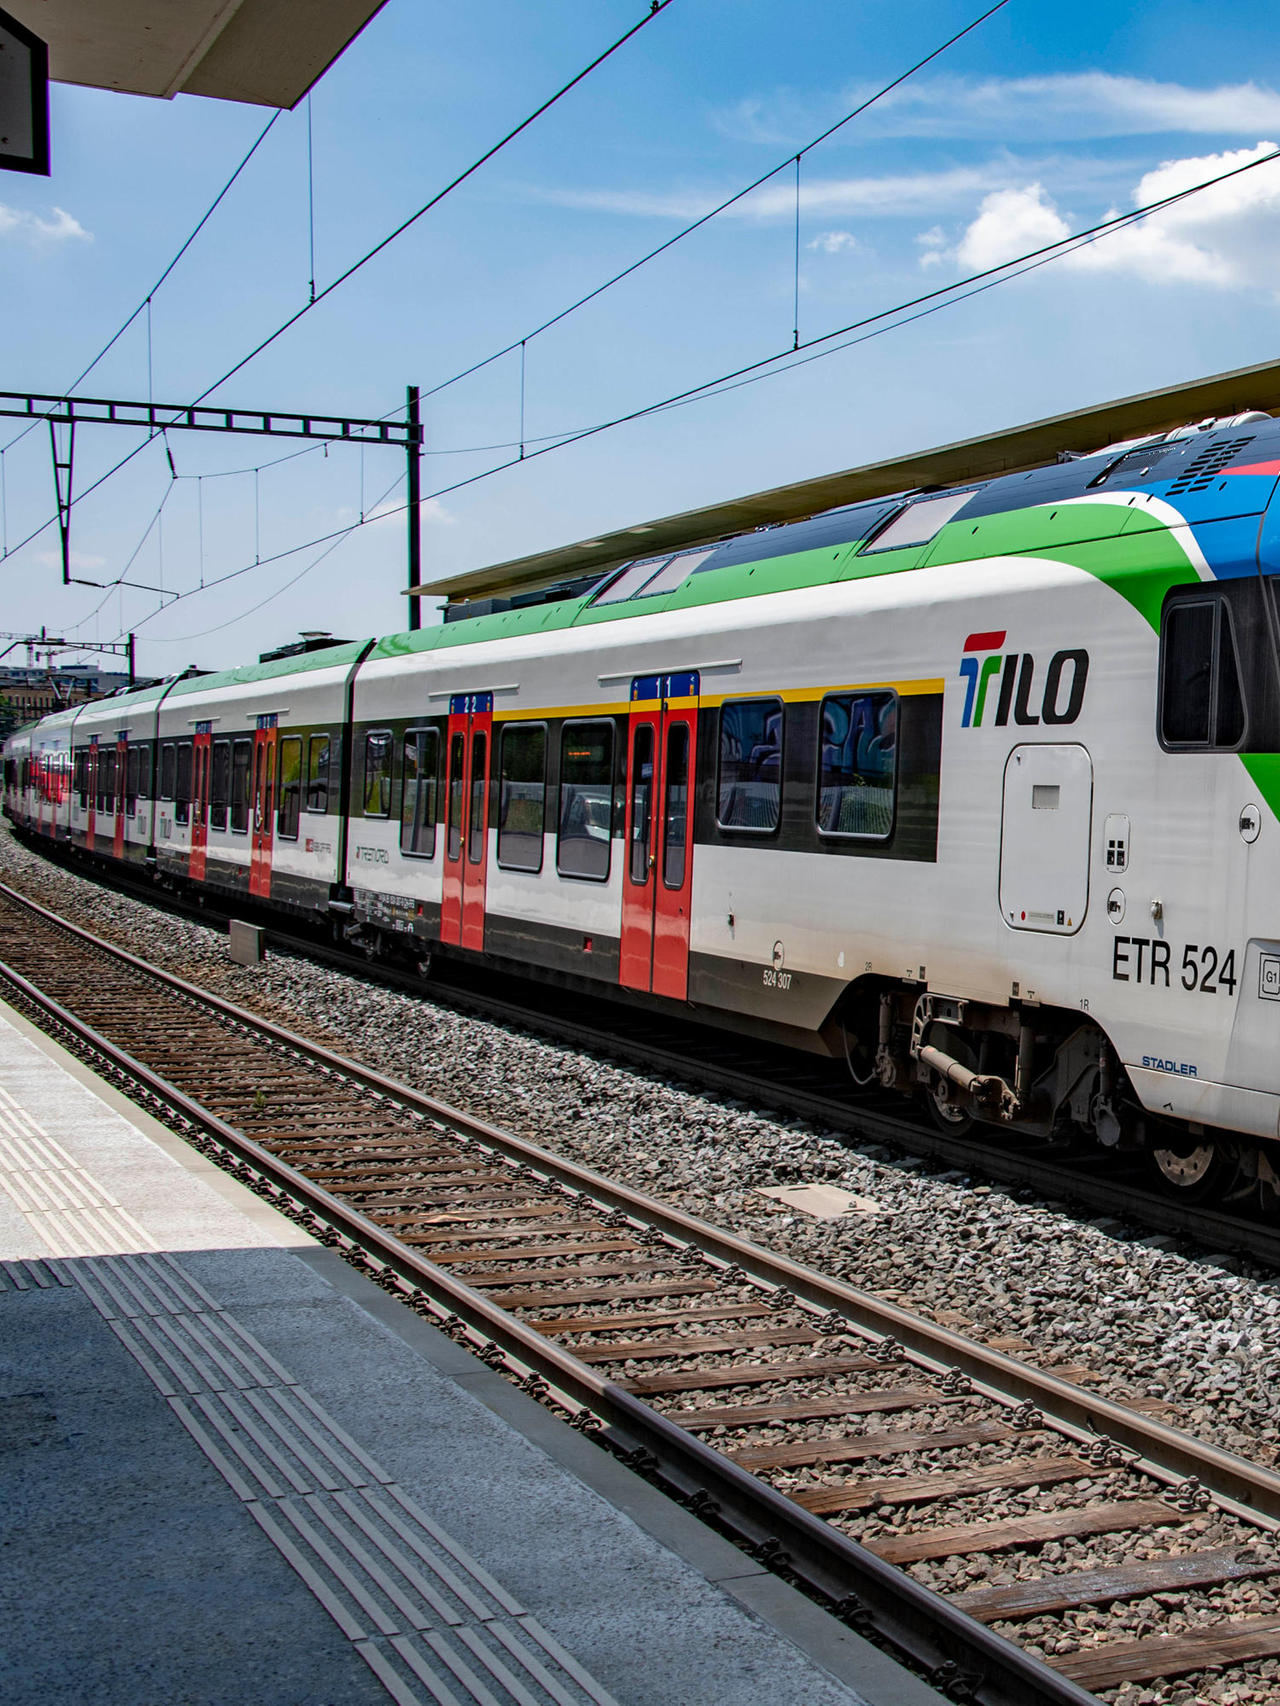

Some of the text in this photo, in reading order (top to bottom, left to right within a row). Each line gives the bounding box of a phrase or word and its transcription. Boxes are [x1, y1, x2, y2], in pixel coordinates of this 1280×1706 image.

[959, 630, 1090, 728] TILO
[464, 695, 477, 714] 2 2
[1113, 935, 1237, 996] ETR 524
[763, 969, 792, 990] 524 307
[1266, 970, 1277, 984] G1
[1142, 1056, 1197, 1077] STADLER
